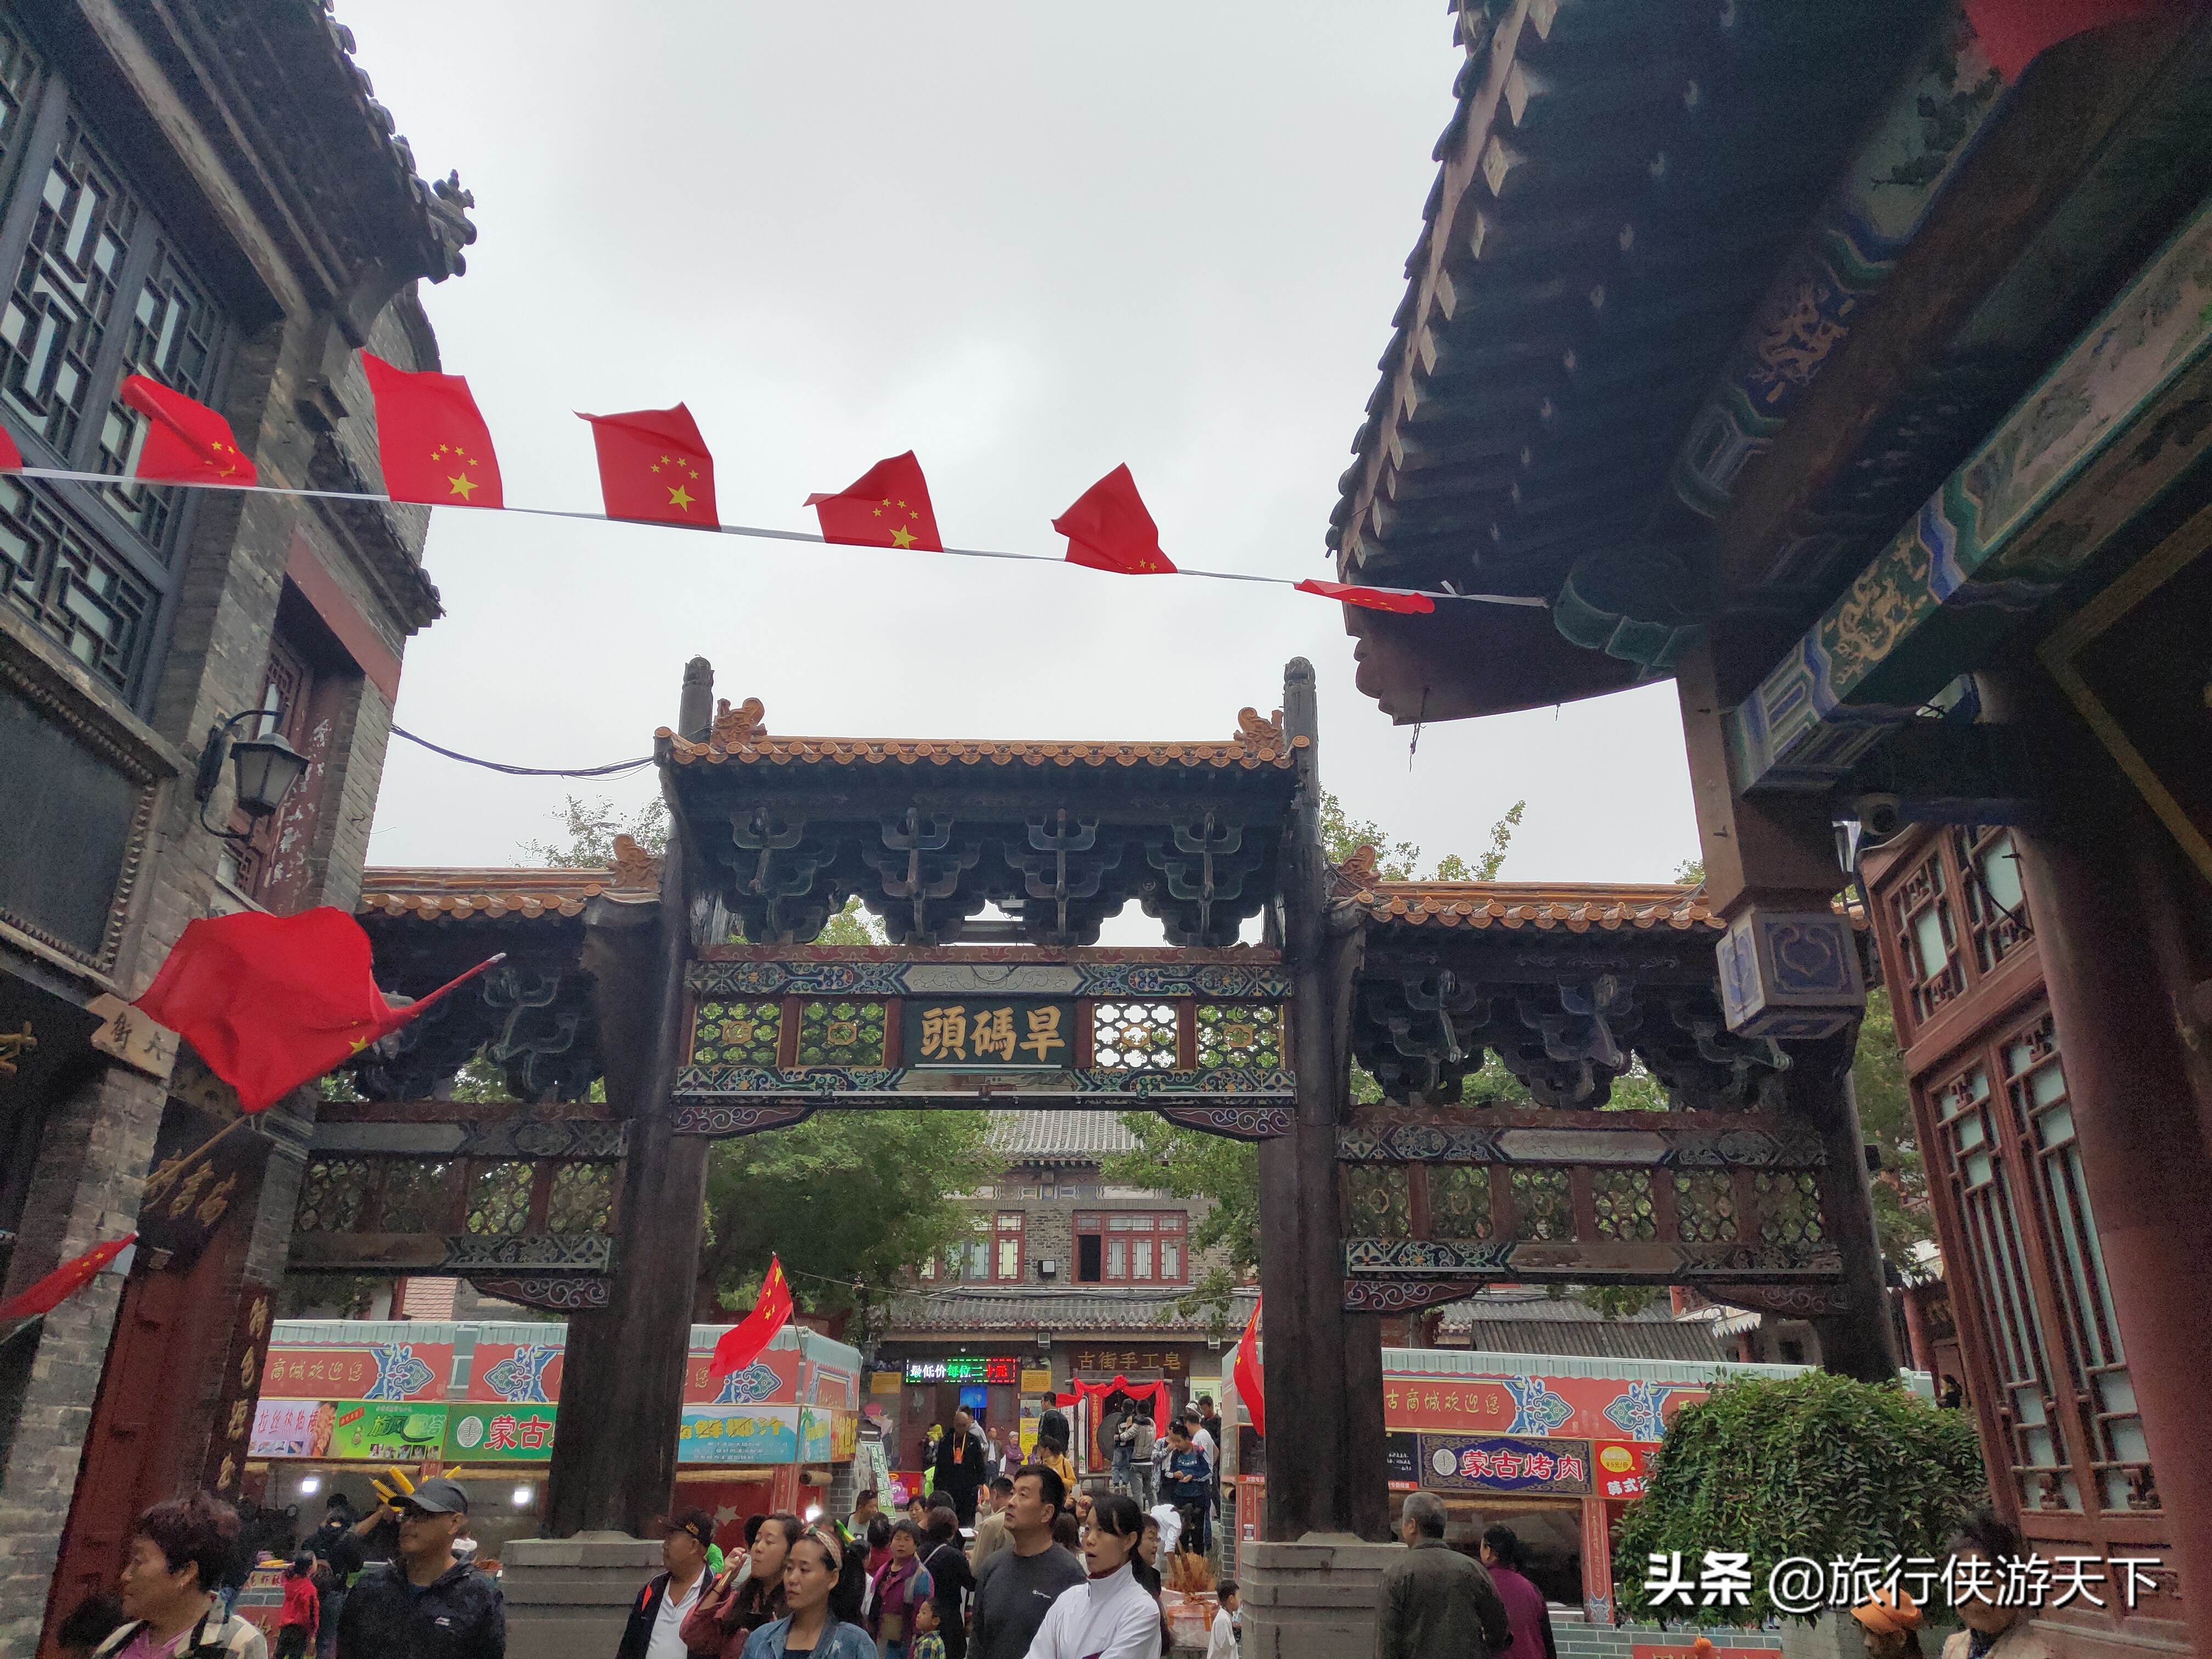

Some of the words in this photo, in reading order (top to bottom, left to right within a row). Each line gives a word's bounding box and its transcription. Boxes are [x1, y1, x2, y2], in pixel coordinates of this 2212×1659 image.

[270, 1358, 363, 1382] 商城欢迎您
[910, 1364, 1008, 1379] 最低价每位二十元
[1077, 1351, 1181, 1370] 古街手工皂
[684, 1366, 709, 1388] 您
[1385, 1388, 1500, 1415] 古商城欢迎您
[483, 1413, 555, 1452] 蒙古
[1459, 1449, 1584, 1482] 蒙古烤肉
[1606, 1476, 1647, 1496] 韩式
